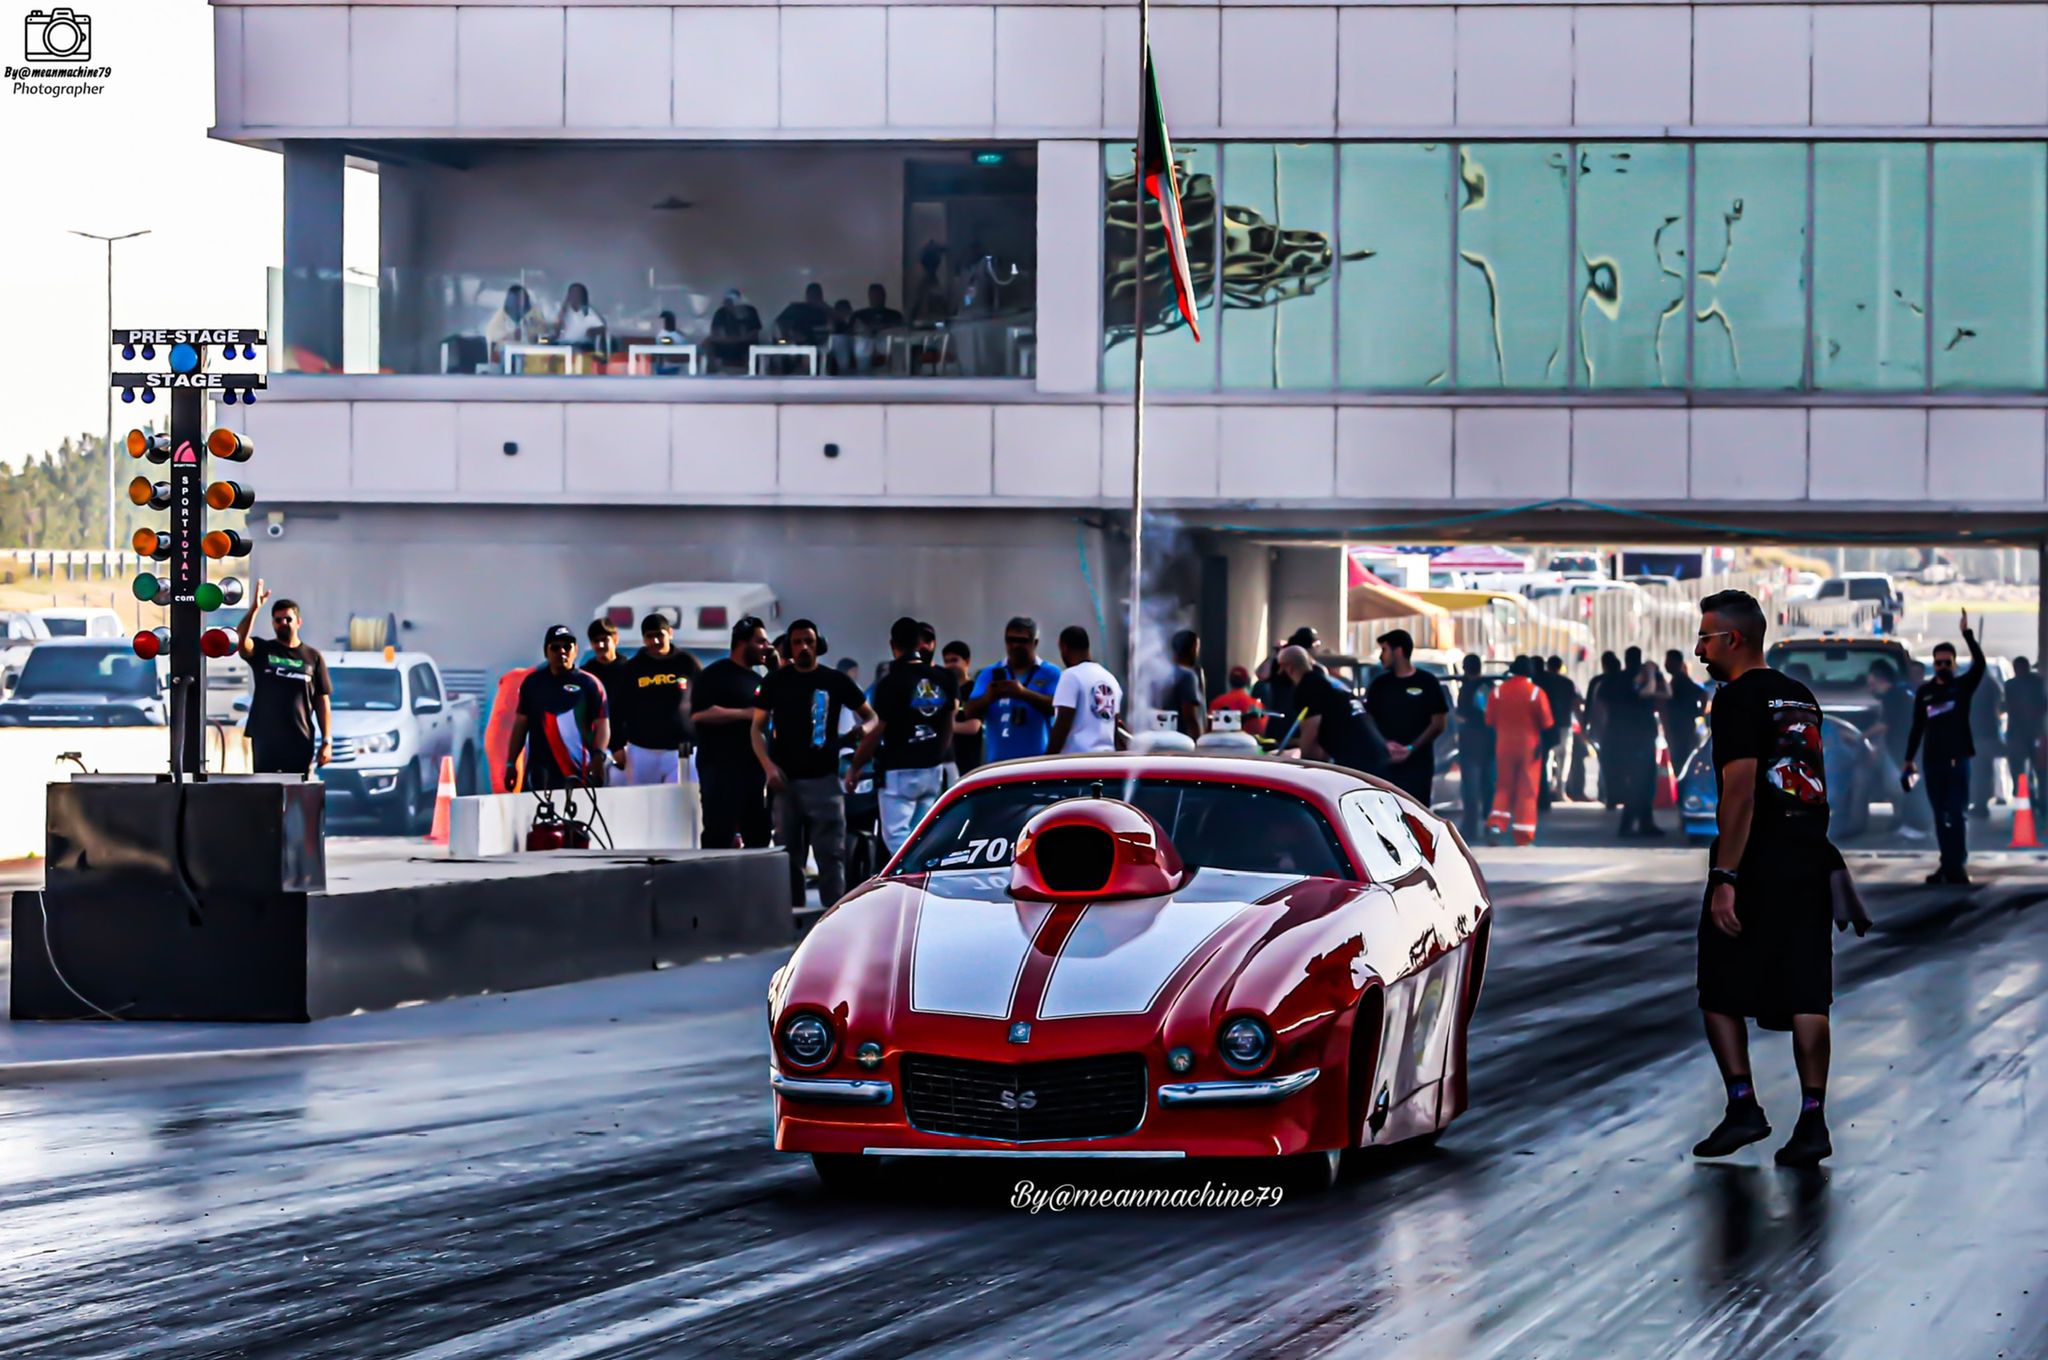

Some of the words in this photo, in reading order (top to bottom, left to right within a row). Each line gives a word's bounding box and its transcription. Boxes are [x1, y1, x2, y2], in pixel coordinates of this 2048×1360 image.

[129, 330, 239, 343] PRE-STAGE
[146, 373, 222, 387] STAGE
[1000, 1089, 1037, 1109] SS
